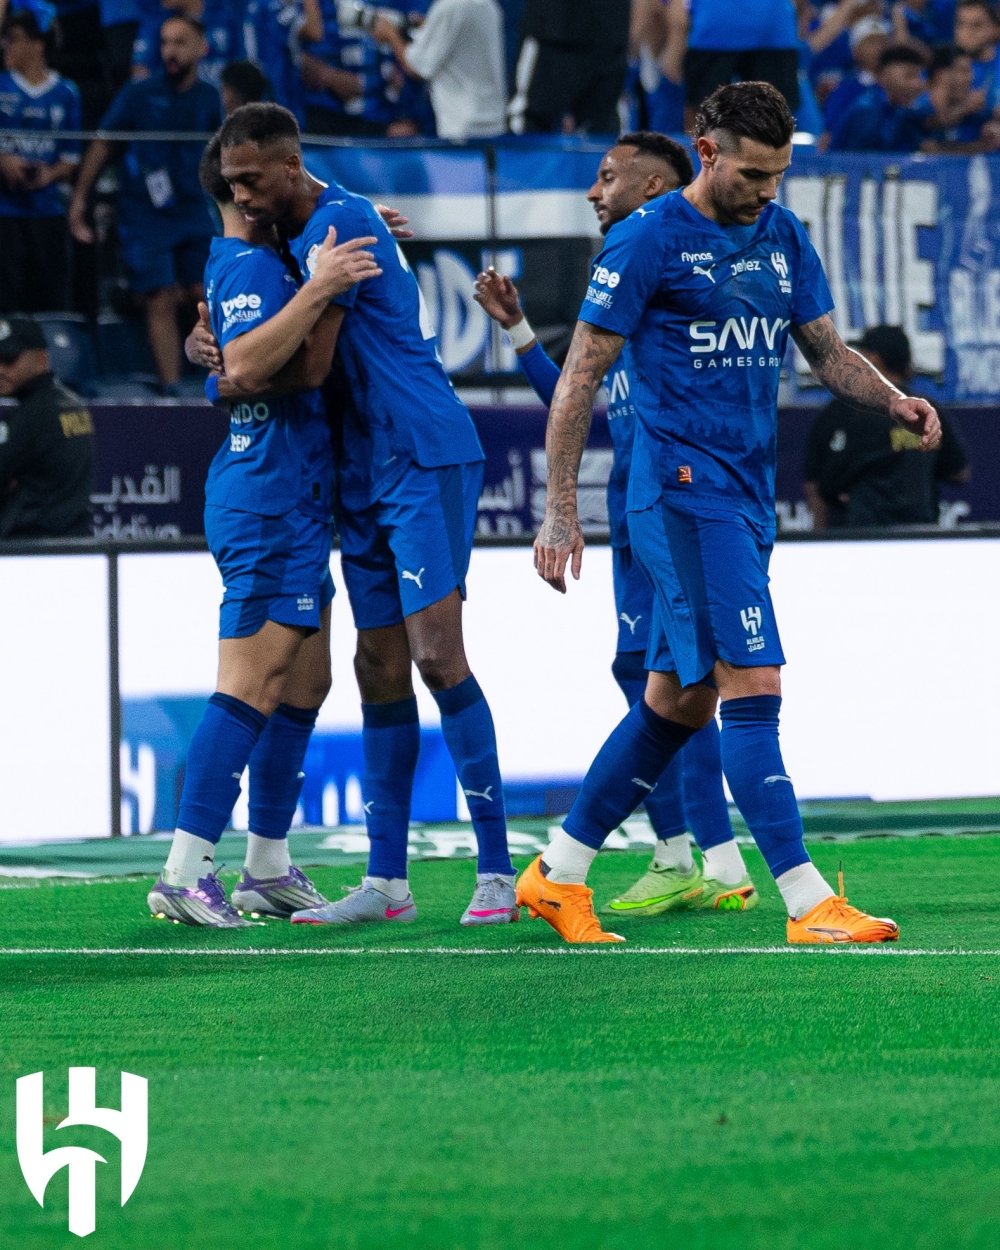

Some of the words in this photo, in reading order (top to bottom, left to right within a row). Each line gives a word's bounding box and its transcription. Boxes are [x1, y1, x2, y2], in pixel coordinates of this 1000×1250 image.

[681, 252, 714, 263] flynas
[221, 294, 262, 318] tree
[693, 357, 753, 369] GAMES
